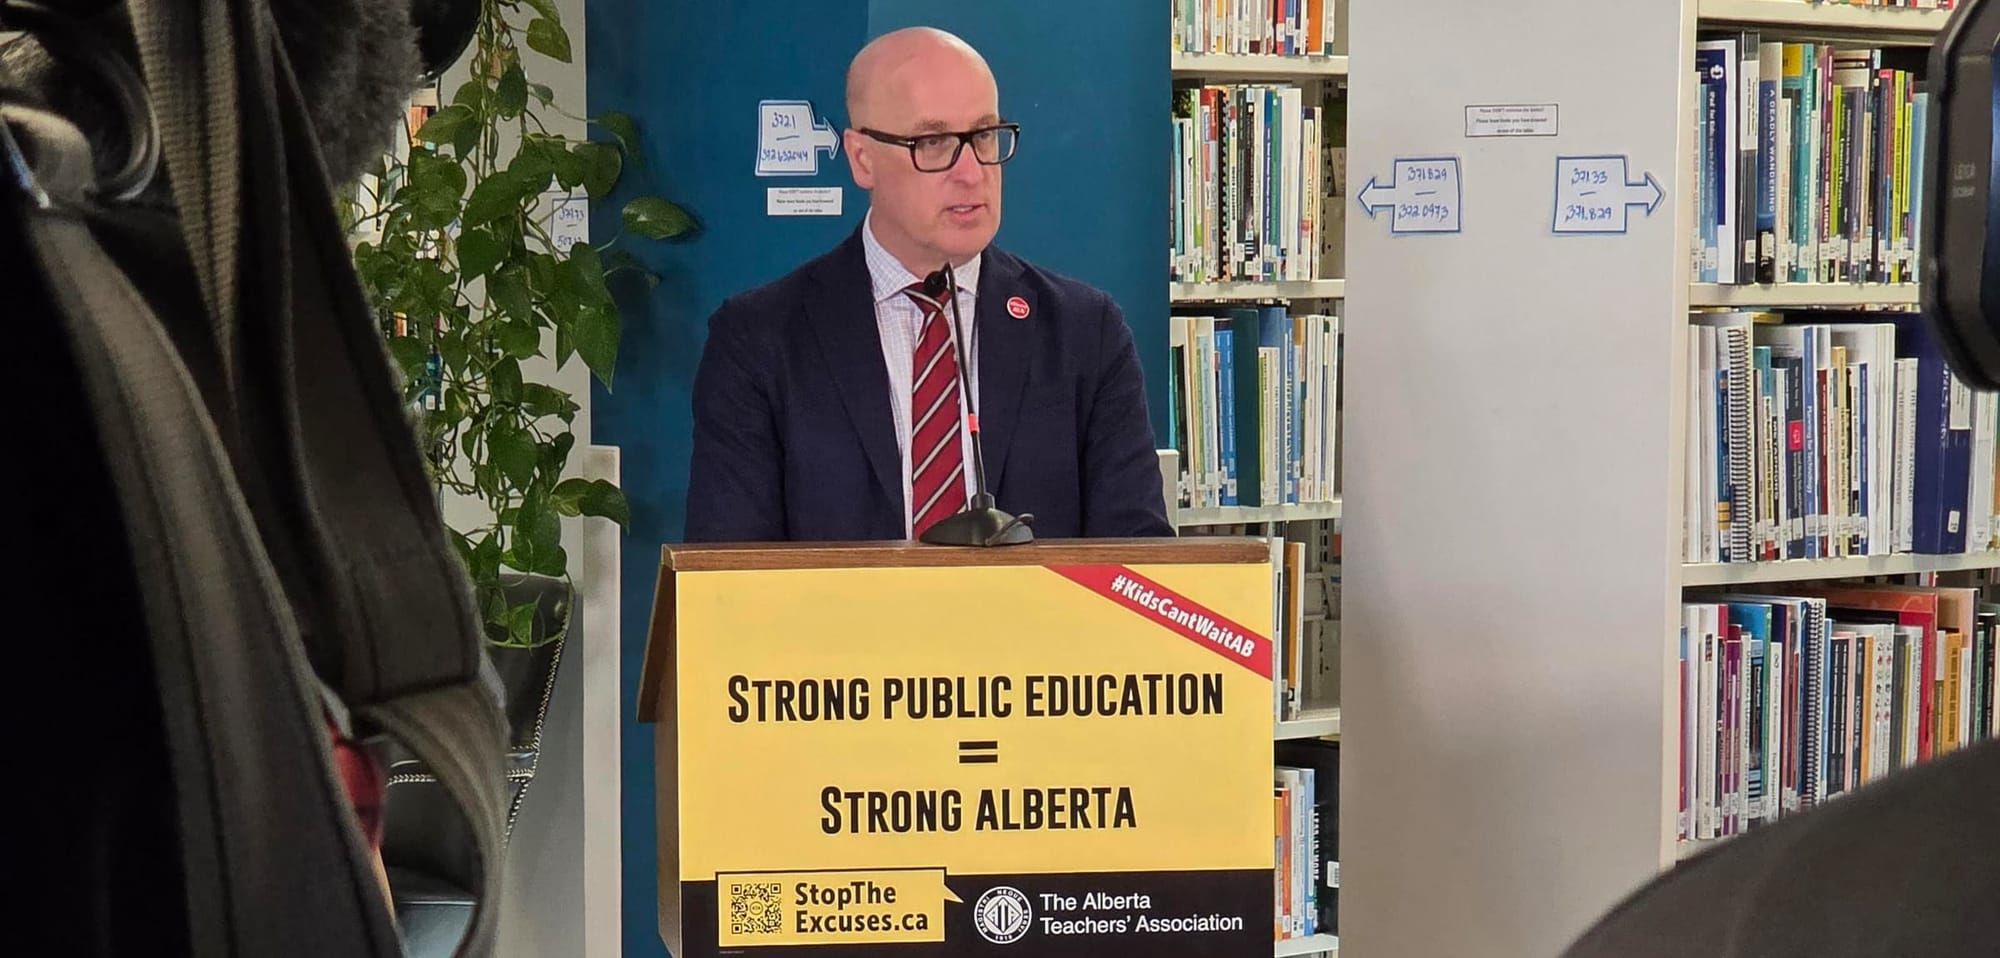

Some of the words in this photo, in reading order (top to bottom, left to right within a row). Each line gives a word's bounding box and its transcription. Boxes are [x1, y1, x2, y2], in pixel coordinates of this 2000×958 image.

[1110, 574, 1256, 658] #KidsCantWaitAB
[727, 674, 869, 722] STRONG
[883, 676, 1012, 720] PUBLIC
[1025, 673, 1224, 718] EDUCATION
[958, 740, 999, 764] =
[821, 786, 962, 834] STRONG
[975, 786, 1137, 832] ALBERTA
[795, 881, 897, 910] StopThe
[1040, 895, 1078, 912] The
[1083, 892, 1151, 912] Alberta
[796, 910, 929, 934] Excuses.ca
[1040, 914, 1132, 936] Teachers'
[1137, 911, 1243, 933] Association
